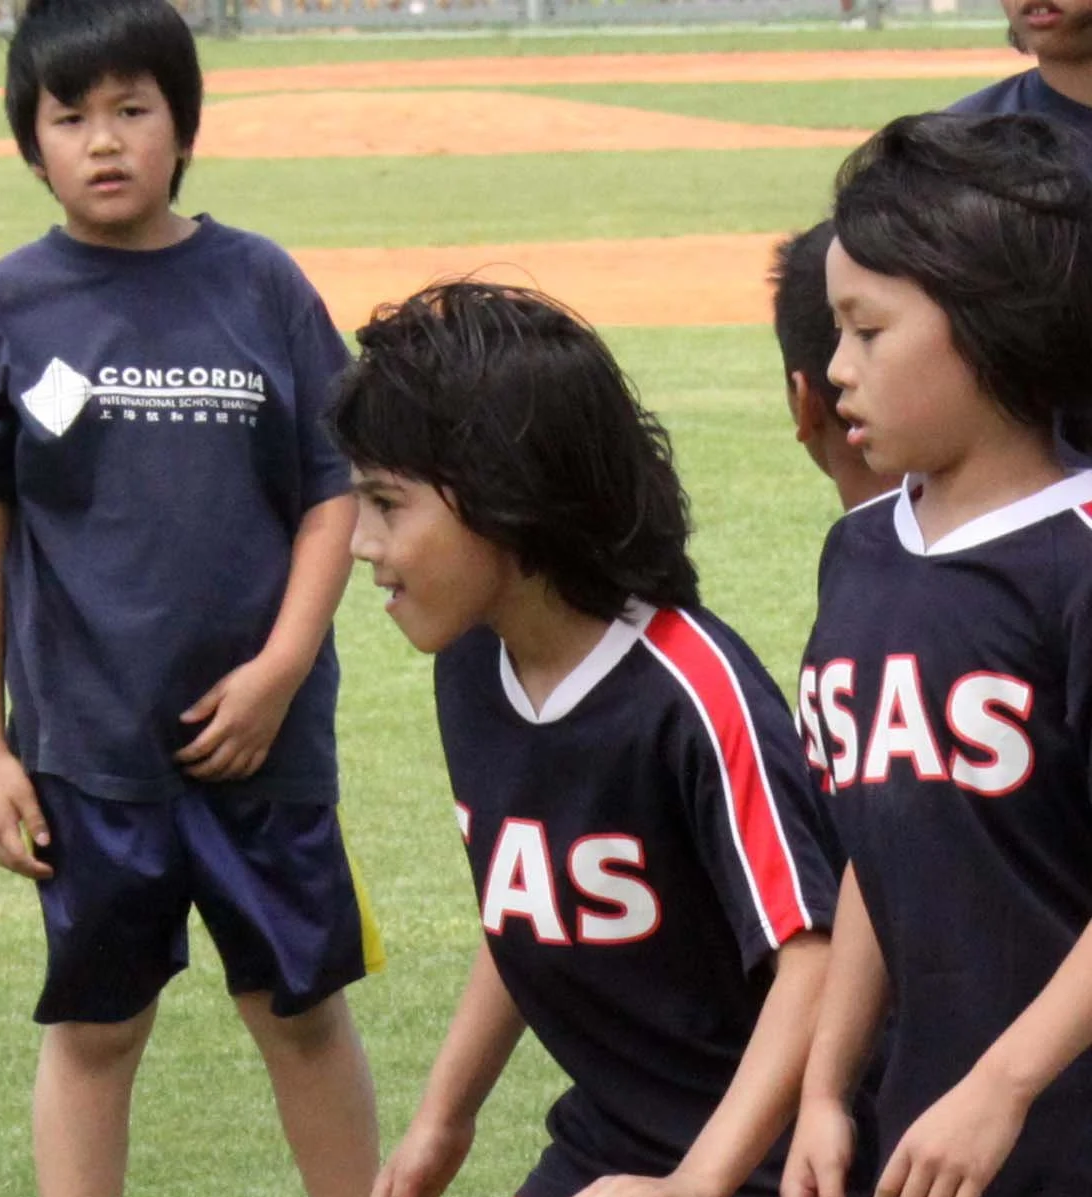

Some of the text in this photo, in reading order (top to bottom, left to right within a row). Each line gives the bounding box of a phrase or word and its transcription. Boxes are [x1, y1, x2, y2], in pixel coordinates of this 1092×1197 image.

[98, 367, 264, 392] CONCORDIA
[99, 395, 176, 408] INTERNATIONAL
[179, 397, 219, 409] SCHOOL
[455, 800, 662, 946] AS
